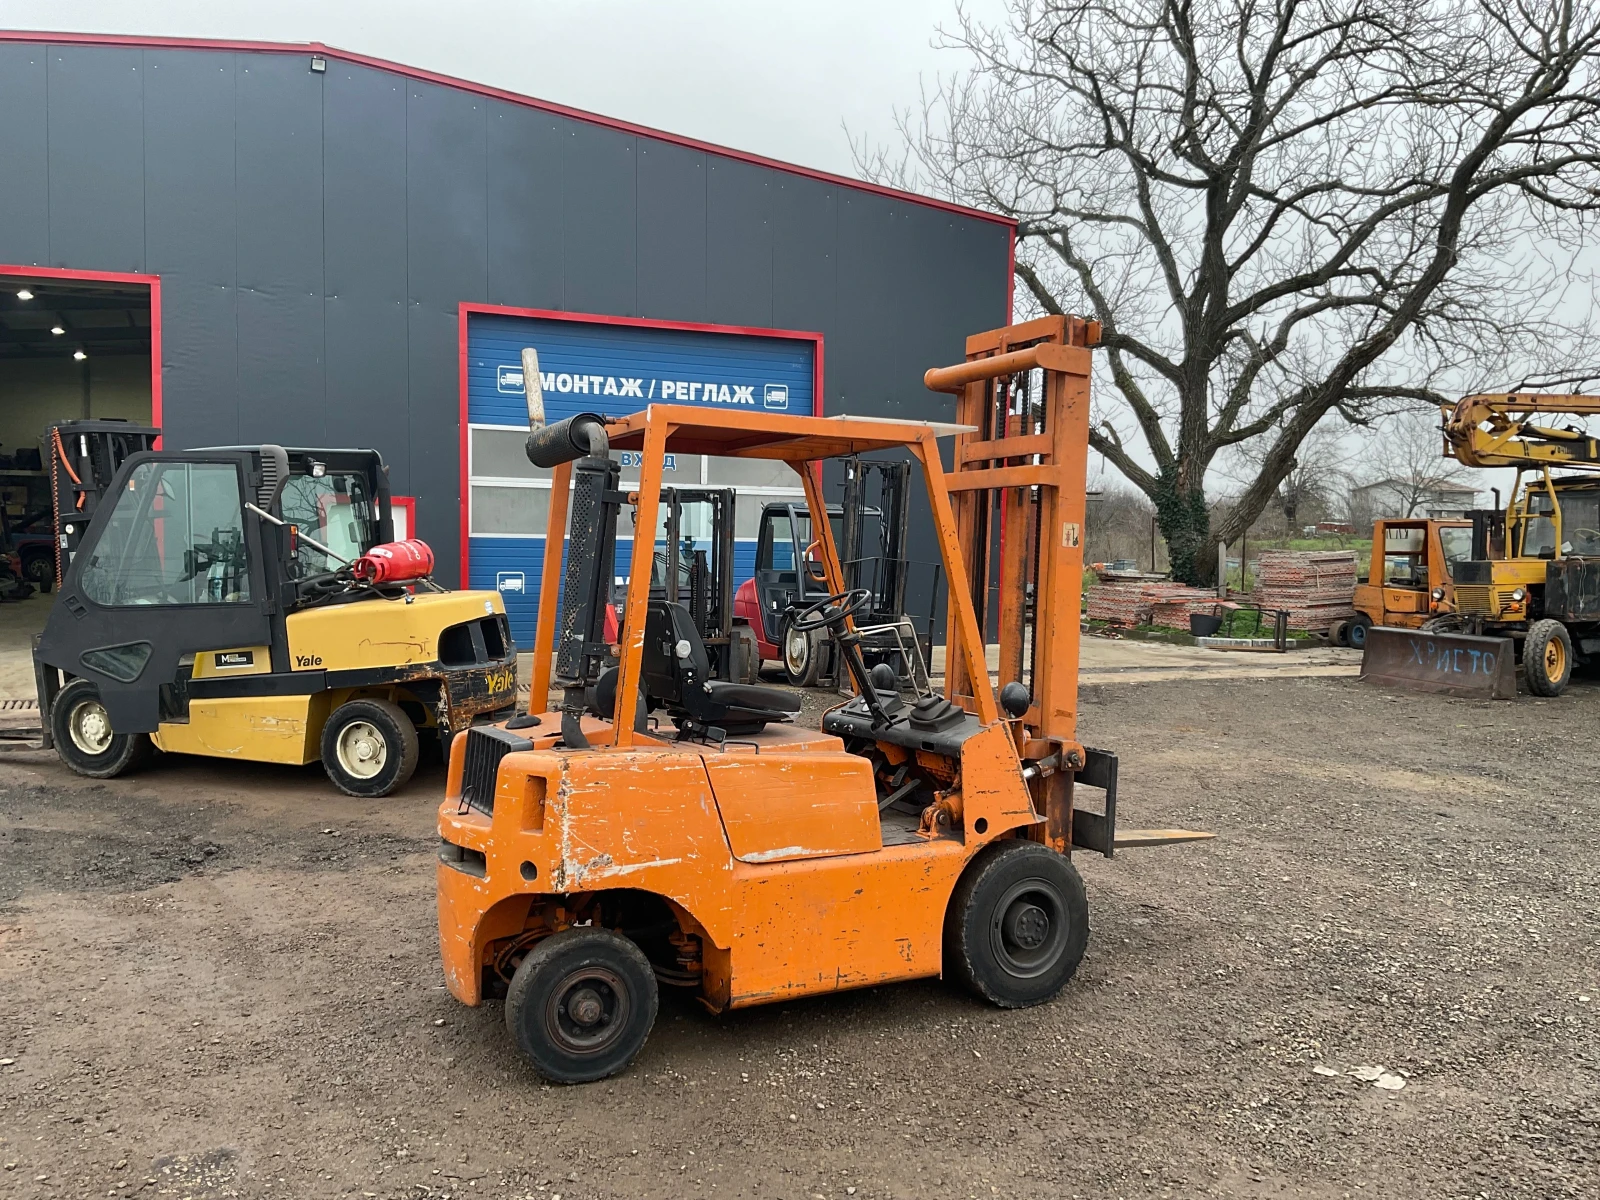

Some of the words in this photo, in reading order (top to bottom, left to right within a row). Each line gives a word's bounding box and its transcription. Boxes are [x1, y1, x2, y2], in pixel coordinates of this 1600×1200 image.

[539, 372, 644, 397] МОНТАЖ
[647, 379, 656, 399] /
[661, 380, 756, 405] РЕГЛАЖ
[621, 451, 677, 472] ВХД
[295, 654, 323, 668] Yale
[1408, 639, 1496, 676] ХРИСТО
[486, 669, 514, 695] Yale
